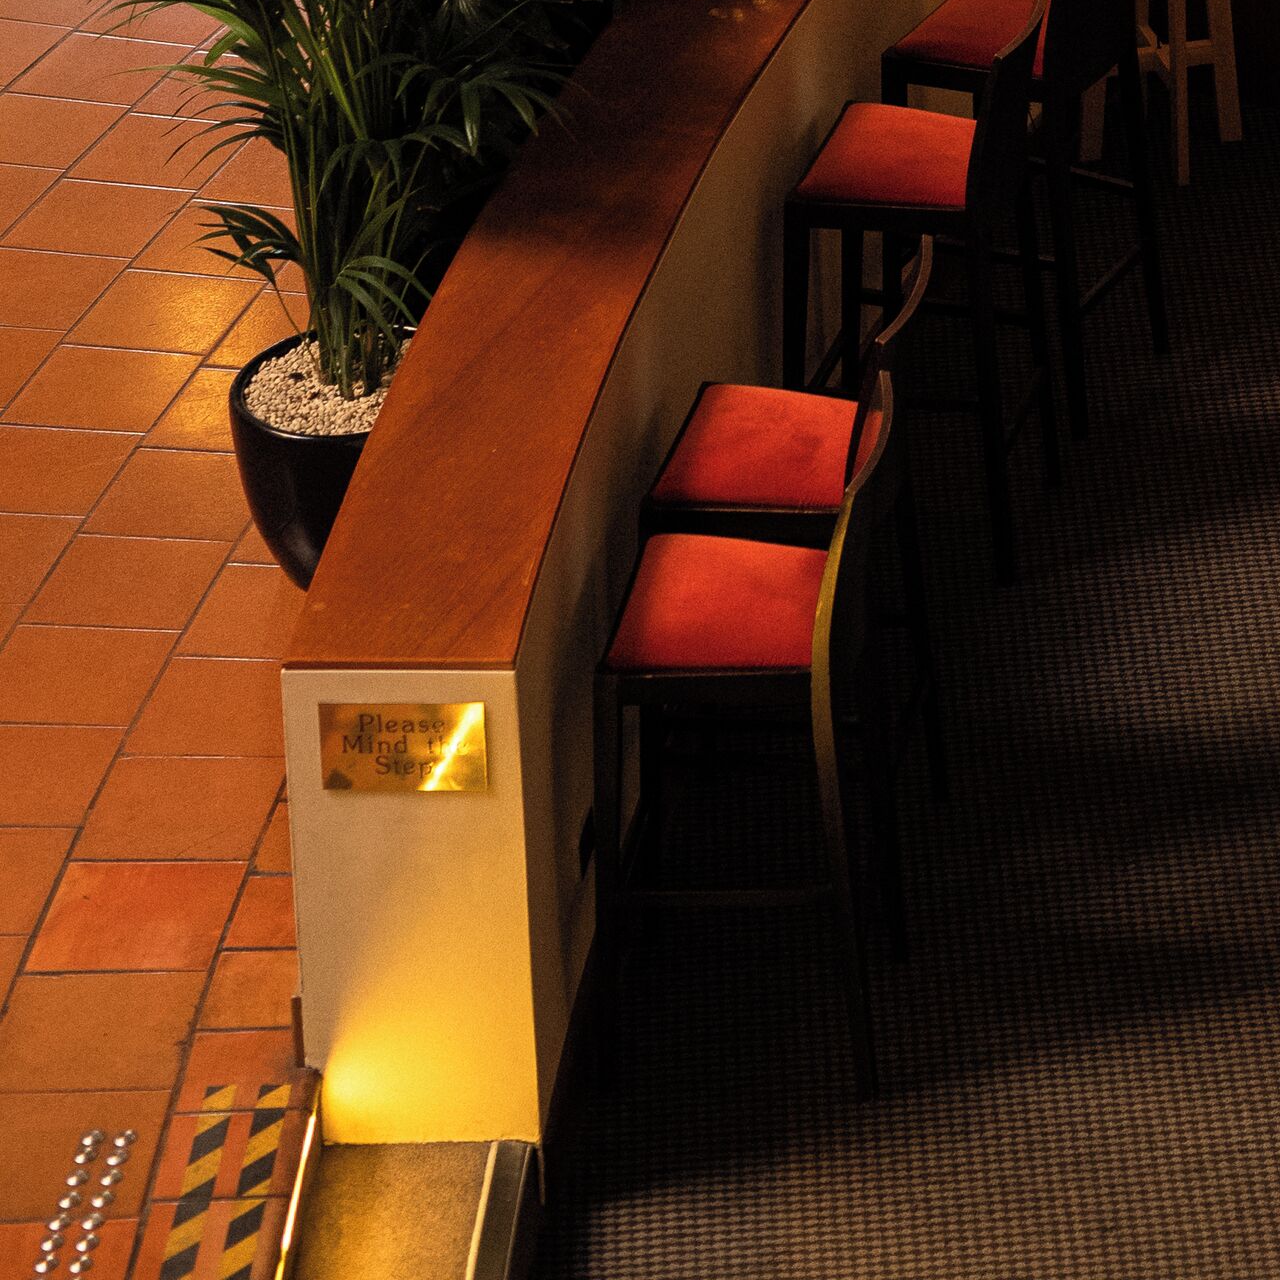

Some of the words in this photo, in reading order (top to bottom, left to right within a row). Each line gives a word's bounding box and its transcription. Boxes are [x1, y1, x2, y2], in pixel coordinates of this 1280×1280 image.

[358, 713, 445, 734] Please
[341, 735, 408, 754] Mind
[375, 755, 433, 779] Step
